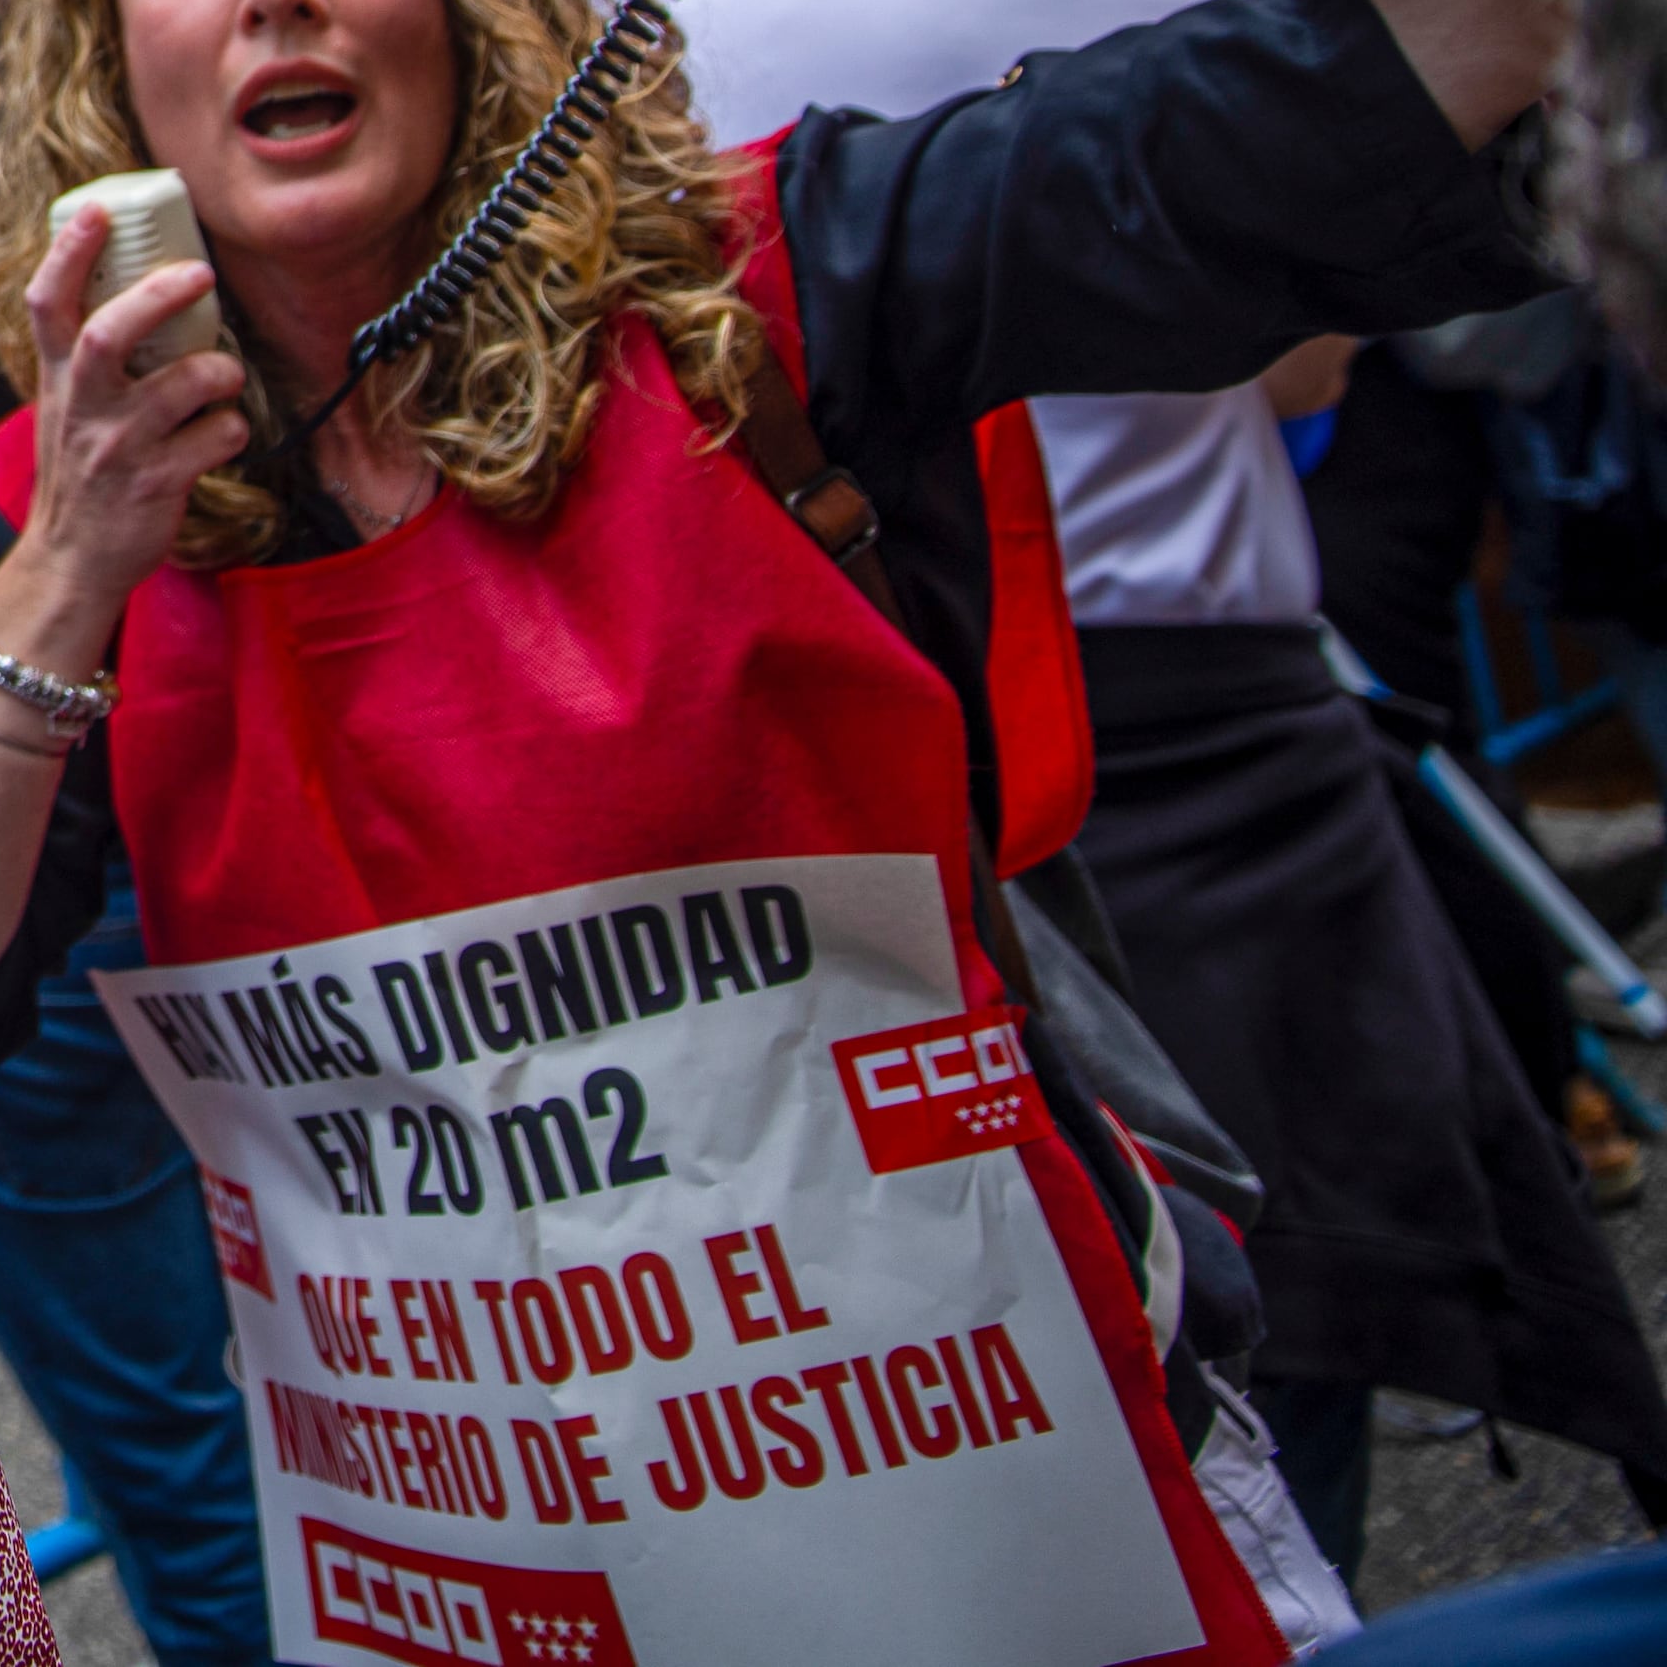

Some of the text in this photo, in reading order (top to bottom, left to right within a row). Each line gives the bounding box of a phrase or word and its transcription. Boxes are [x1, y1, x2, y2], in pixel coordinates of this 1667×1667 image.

[219, 953, 383, 1090] MÁS
[371, 883, 814, 1074] DIGNIDAD
[295, 1066, 668, 1217] EN 20 m2
[296, 1223, 831, 1386] QUE EN TODO EL
[263, 1322, 1057, 1526] MINISTERIO DE JUSTICIA
[312, 1539, 504, 1667] CCOO
